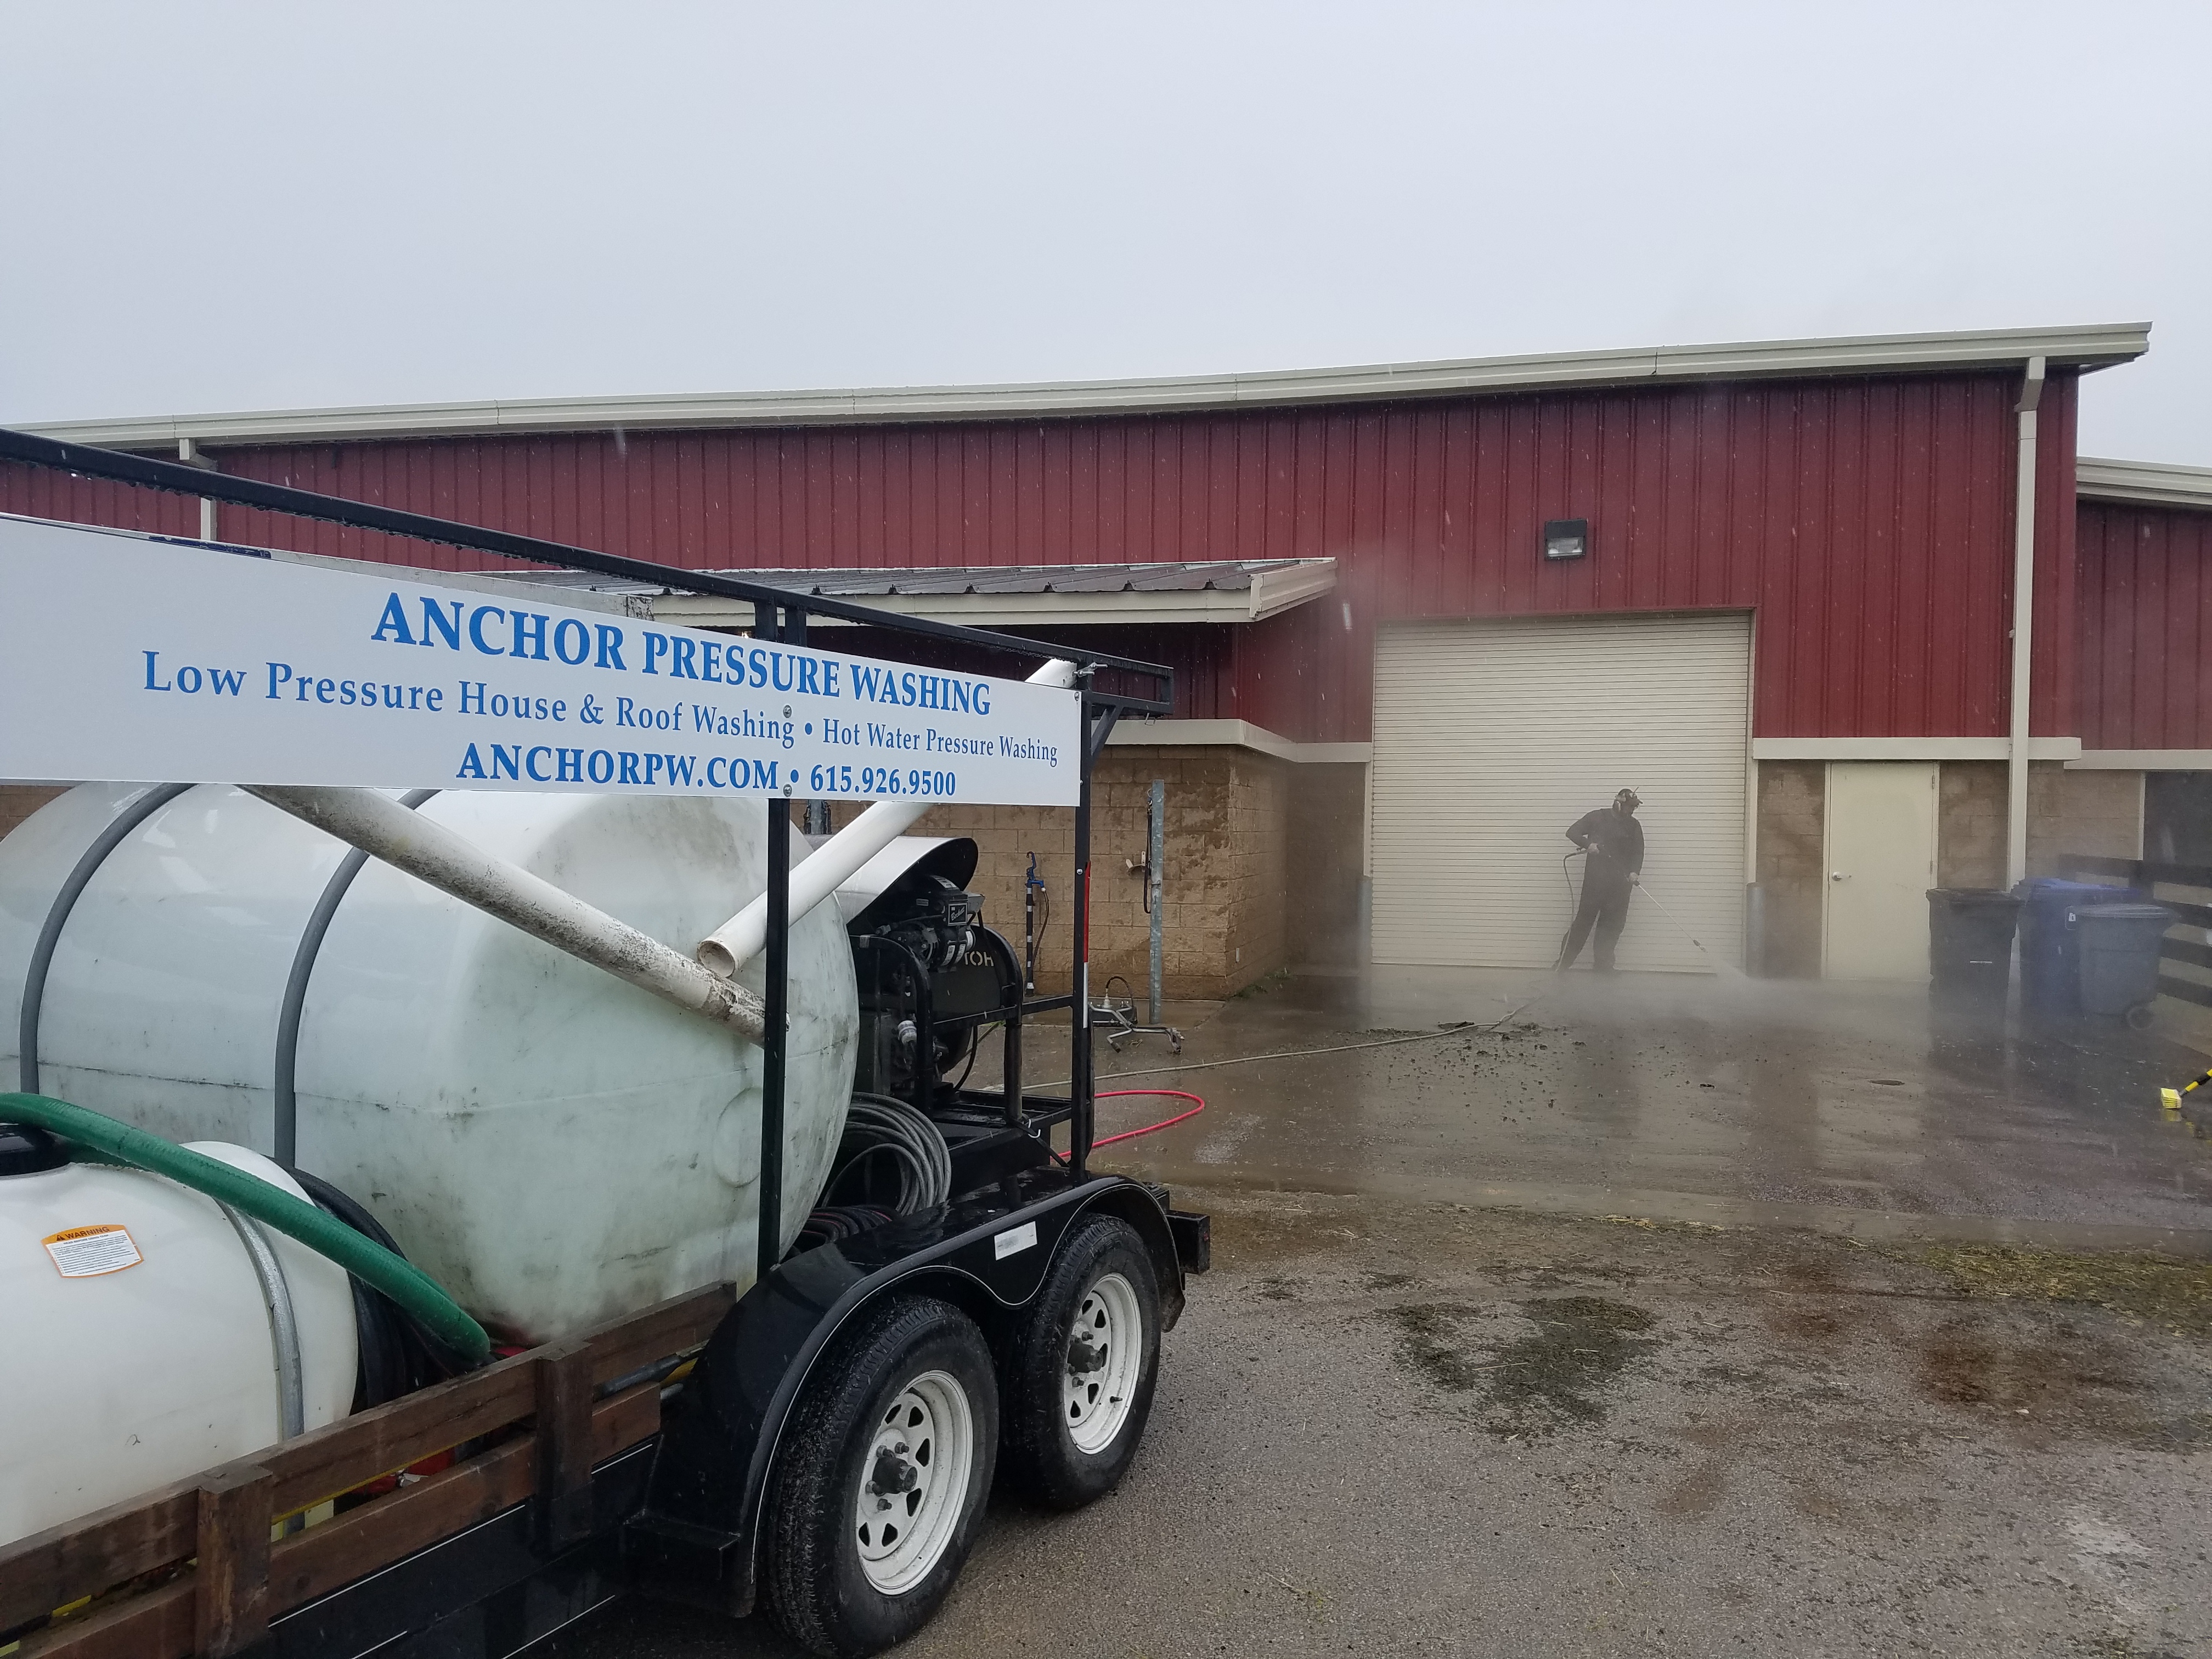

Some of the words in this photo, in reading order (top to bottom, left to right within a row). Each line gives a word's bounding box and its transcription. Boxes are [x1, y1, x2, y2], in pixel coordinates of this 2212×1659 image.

[371, 592, 627, 671] ANCHOR
[642, 631, 840, 697] PRESSURE
[850, 664, 991, 715] WASHING
[142, 651, 247, 696] Low
[265, 662, 443, 712] Pressure
[458, 681, 566, 721] House
[580, 694, 604, 725] &
[616, 697, 682, 731] Roof
[692, 704, 794, 749] Washing
[823, 718, 860, 746] Hot
[867, 723, 920, 750] Water
[926, 729, 994, 757] Pressure
[999, 736, 1058, 766] Washing
[456, 742, 778, 789] ANCHORPW.COM
[810, 764, 956, 796] 615.926.9500
[65, 1226, 110, 1239] WARNING
